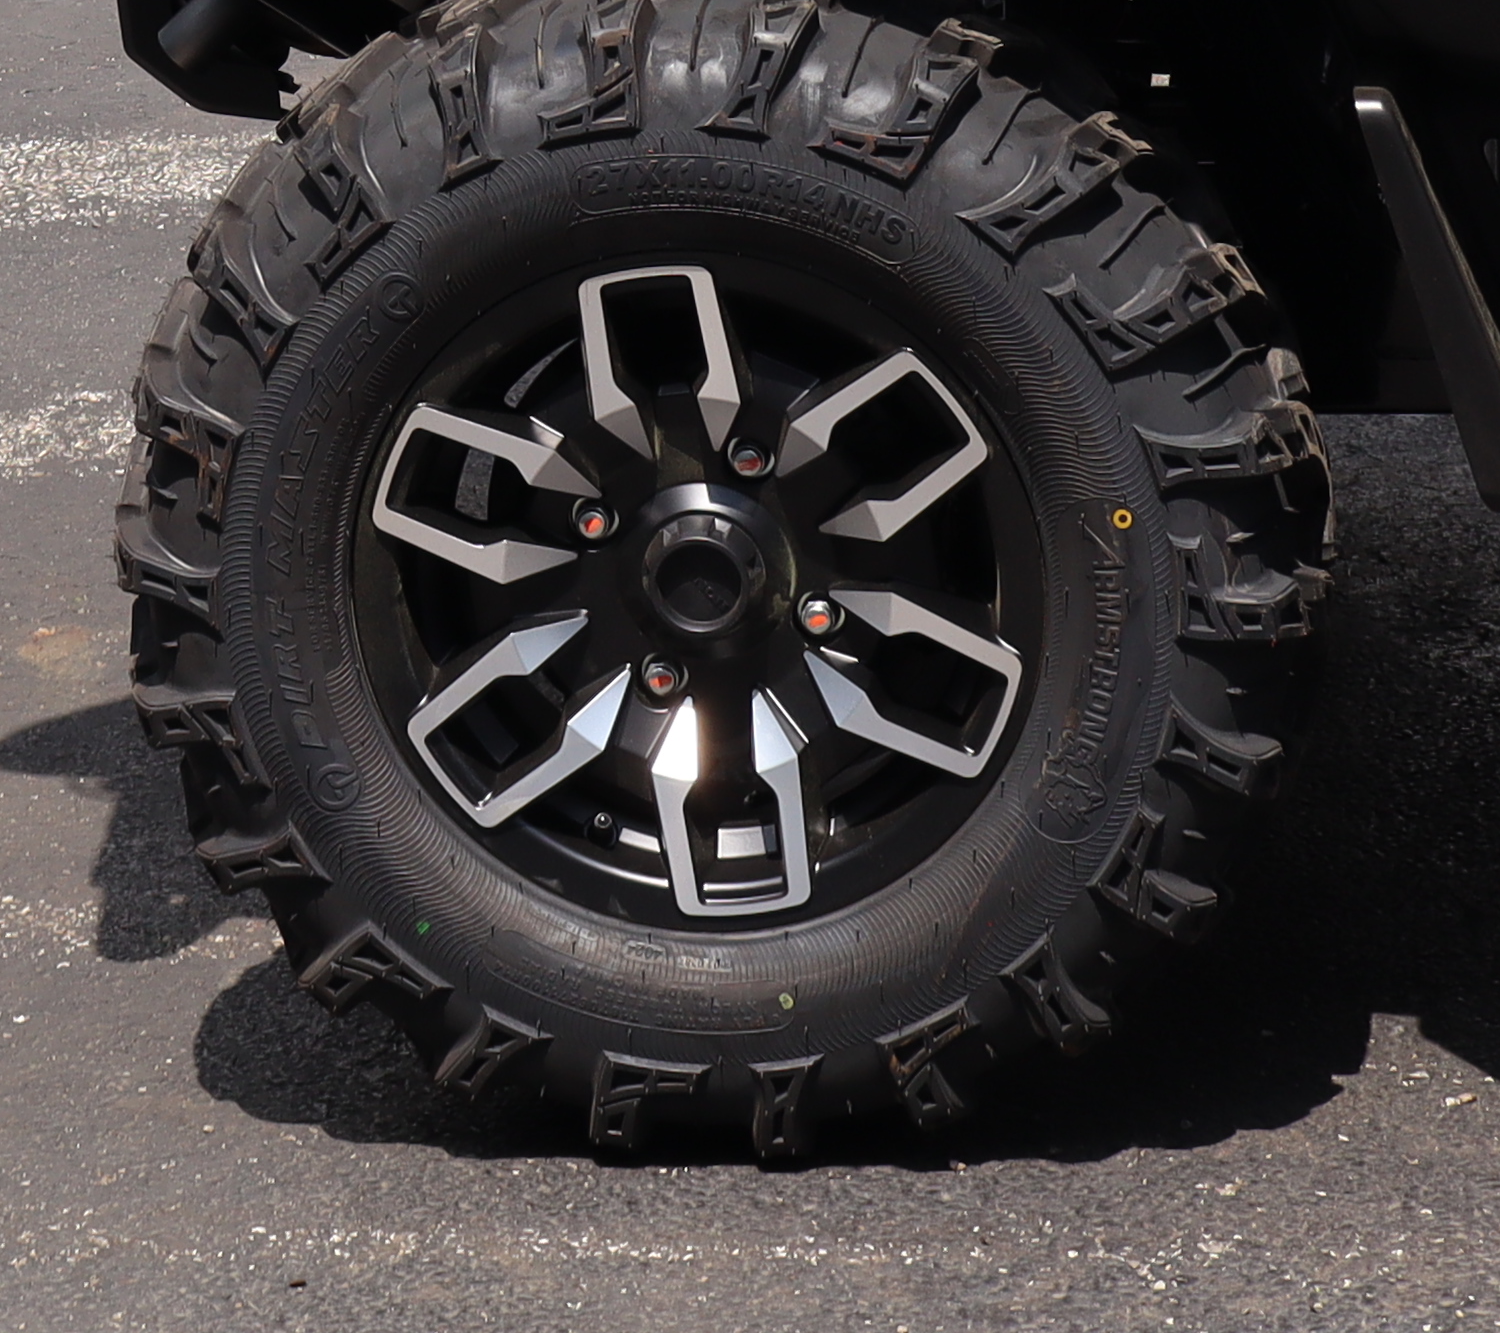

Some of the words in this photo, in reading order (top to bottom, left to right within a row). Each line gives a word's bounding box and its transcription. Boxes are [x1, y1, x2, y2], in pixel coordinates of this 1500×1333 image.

[628, 190, 661, 205] NOT
[666, 190, 699, 204] FOR
[829, 192, 907, 245] NHS
[266, 315, 380, 577] MASTER
[266, 596, 328, 749] DIRT
[1077, 517, 1126, 765] ARMSTRONG
[627, 941, 664, 962] 4024
